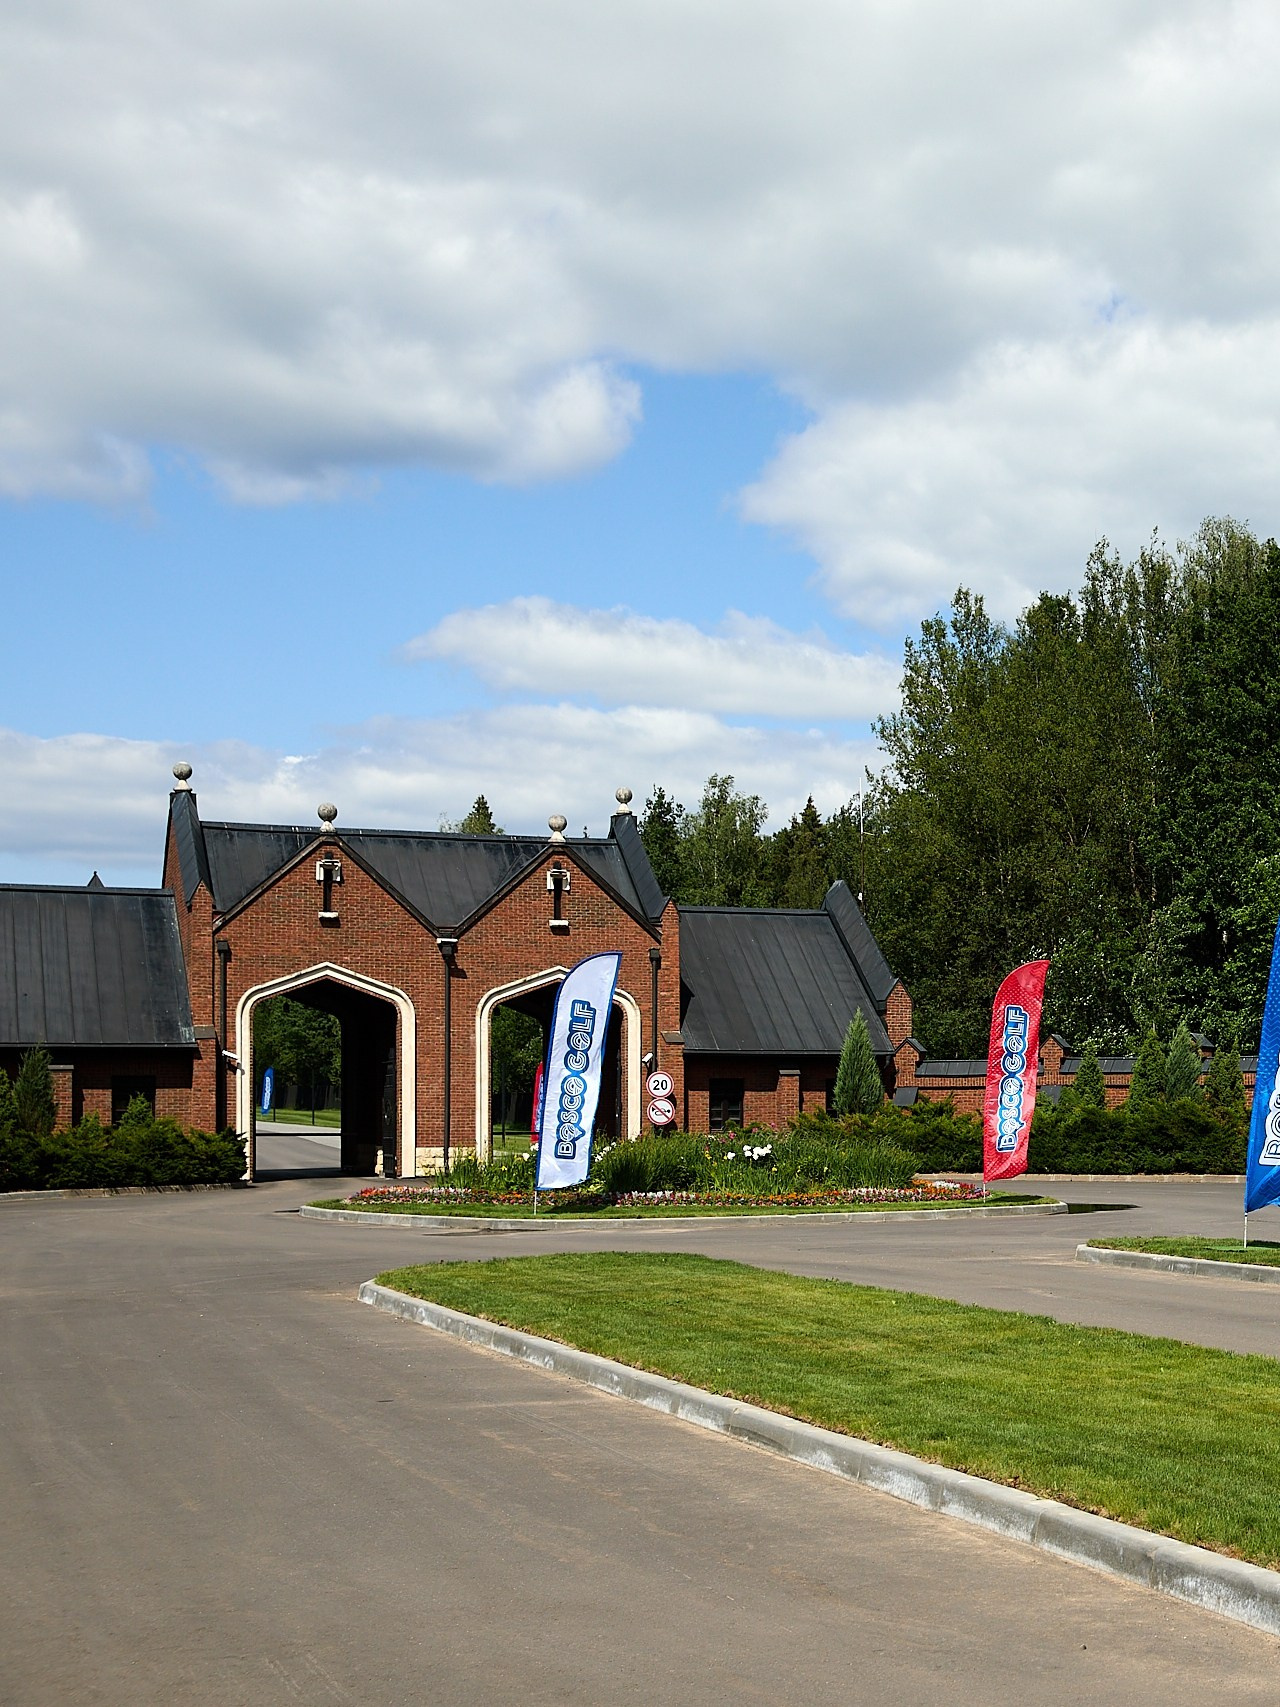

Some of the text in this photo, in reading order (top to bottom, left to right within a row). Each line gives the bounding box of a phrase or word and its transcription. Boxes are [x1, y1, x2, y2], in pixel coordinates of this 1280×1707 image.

[557, 1002, 595, 1157] BOSCO GOLF
[653, 1080, 668, 1091] 20
[1000, 1009, 1028, 1149] BOSCO GOLF
